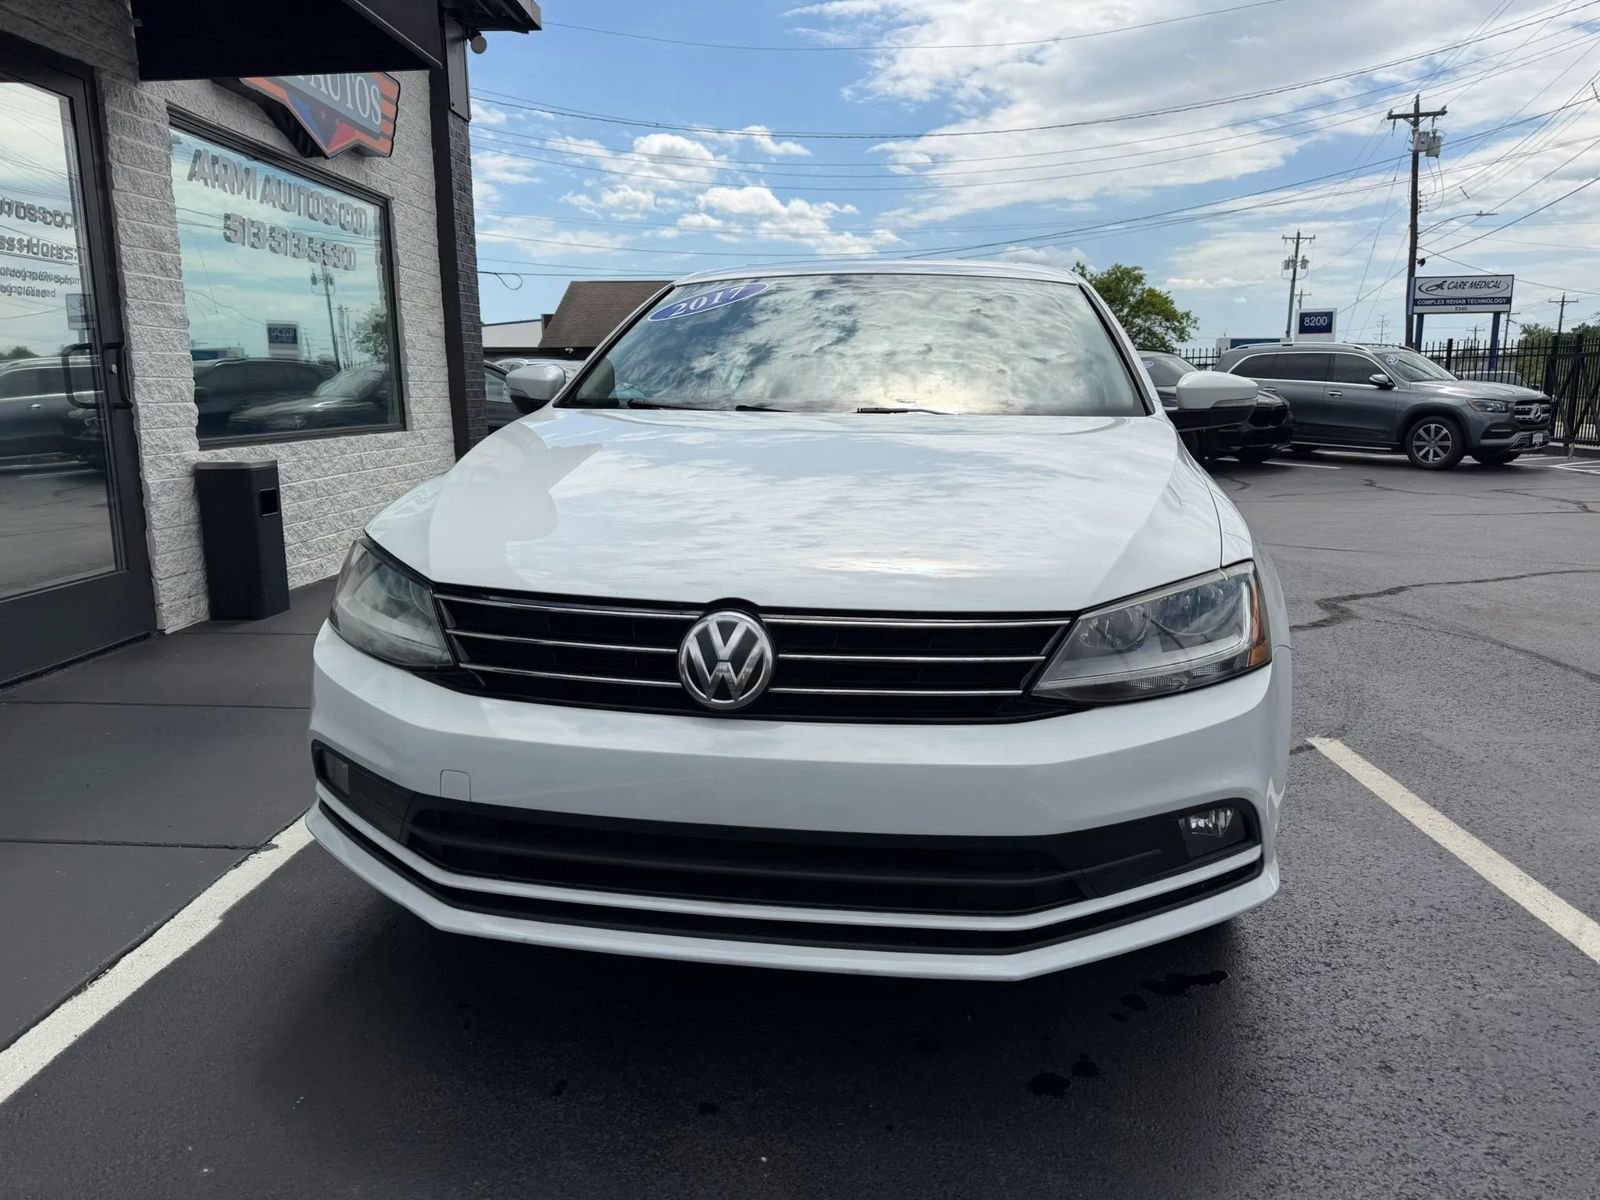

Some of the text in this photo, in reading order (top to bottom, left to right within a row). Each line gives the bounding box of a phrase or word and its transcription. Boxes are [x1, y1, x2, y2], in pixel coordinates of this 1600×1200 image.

[188, 148, 257, 201] ARM
[259, 174, 338, 225] AUTOS
[1447, 279, 1502, 290] CARE MEDICAL
[668, 284, 747, 318] 2017
[1303, 315, 1328, 327] 8200
